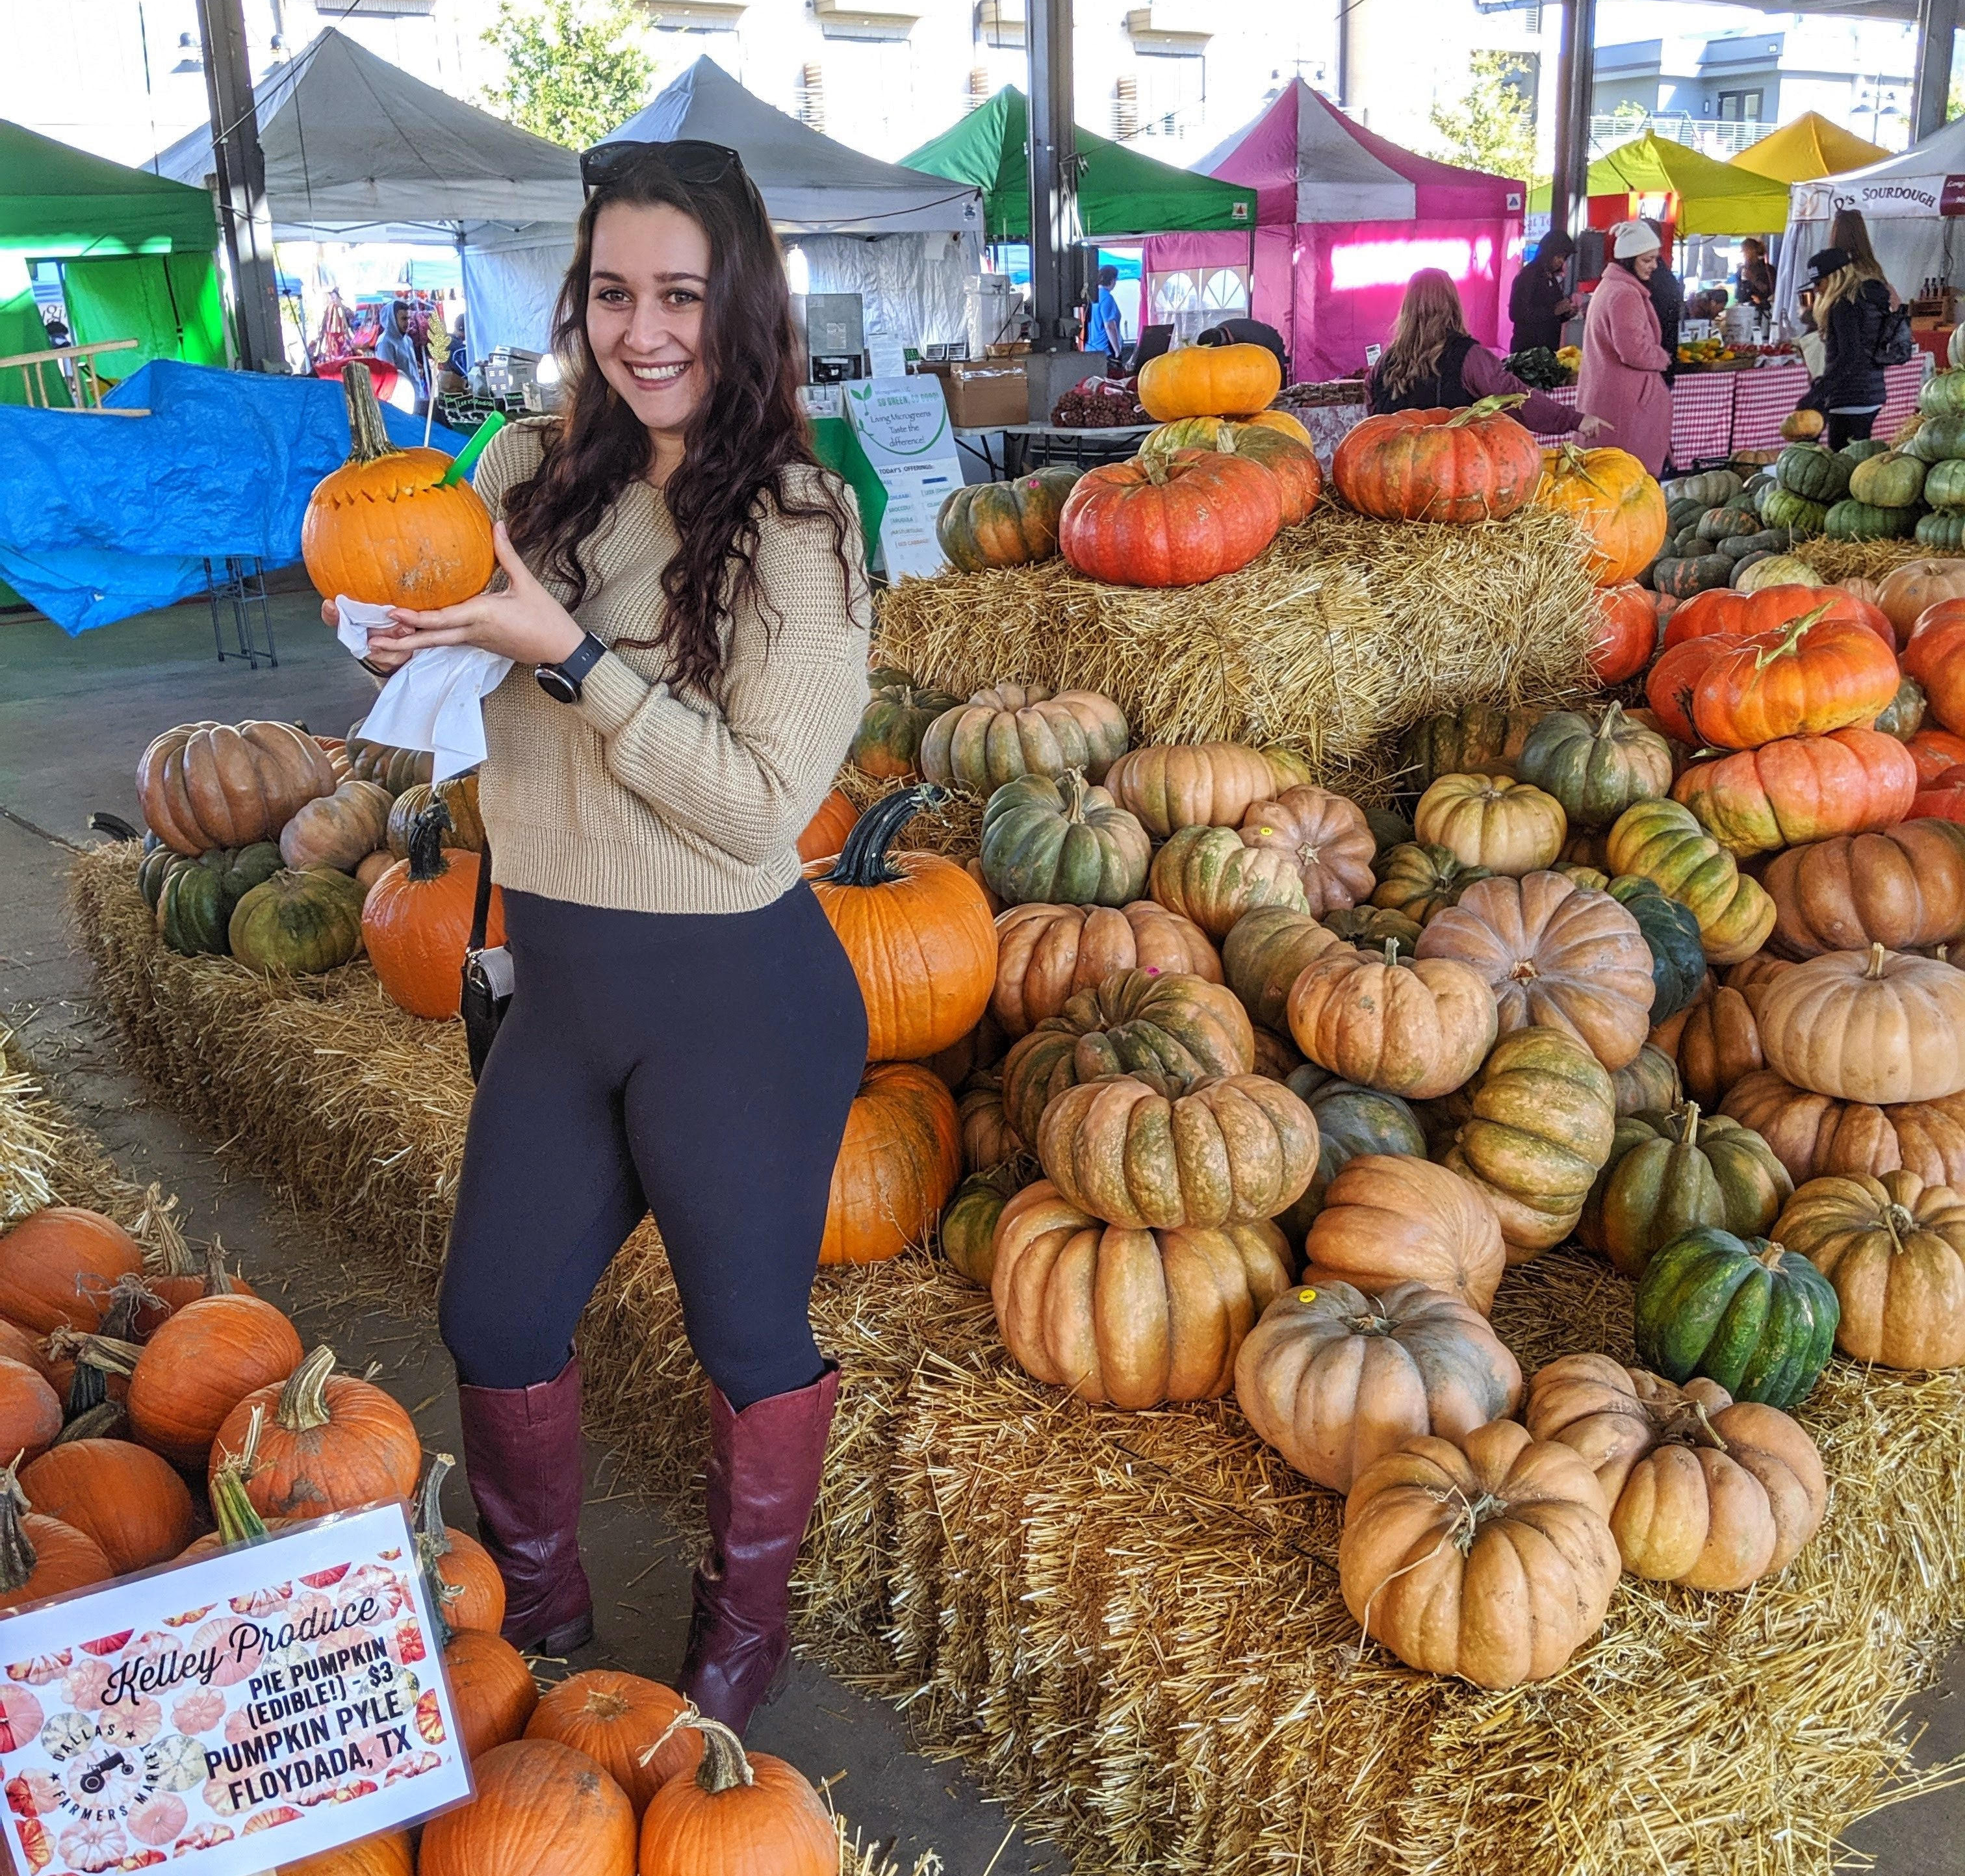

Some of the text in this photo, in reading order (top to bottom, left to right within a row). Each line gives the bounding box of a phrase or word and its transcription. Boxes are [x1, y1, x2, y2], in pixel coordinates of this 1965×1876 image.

[1862, 187, 1936, 207] SOURDOUGH
[870, 411, 931, 424] Living Microgreens
[890, 435, 925, 447] difference!
[908, 423, 919, 431] the
[101, 1597, 379, 1706] Kelley Produce
[248, 1637, 388, 1700] PIE PUMPKIN
[247, 1675, 347, 1730] (EDIBLE!)
[368, 1661, 394, 1688] $3
[53, 1724, 115, 1762] DALLAS
[203, 1690, 403, 1779] PUMPKIN PYLE
[53, 1742, 160, 1821] FARMERS MARKET
[228, 1724, 412, 1810] FLOYDADA, TX
